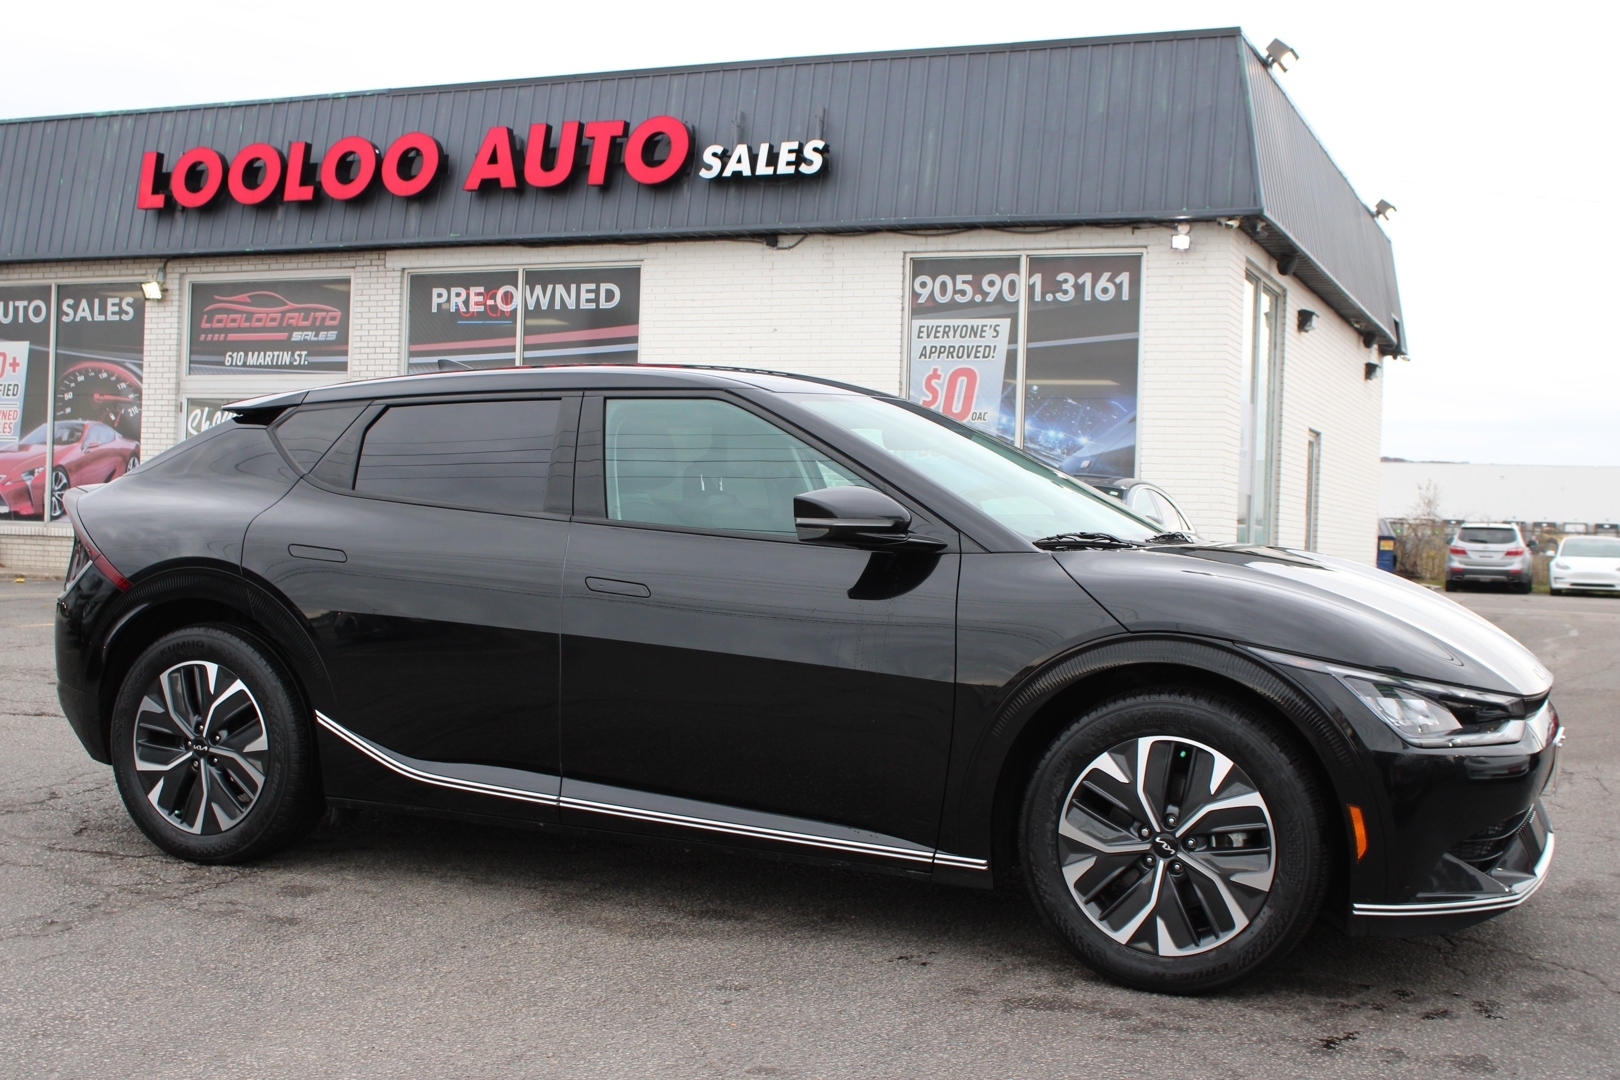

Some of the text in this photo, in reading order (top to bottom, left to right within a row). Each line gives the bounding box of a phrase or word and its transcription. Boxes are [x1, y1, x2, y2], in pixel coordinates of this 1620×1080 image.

[137, 115, 826, 210] LOOLOO AUTO SALES
[913, 272, 1131, 304] 905.901.3161
[431, 283, 621, 313] PRE-OWNED
[62, 296, 134, 322] SALES
[200, 311, 342, 328] LOOLOO AUTO
[290, 330, 339, 341] SALES
[916, 323, 1001, 339] EVERYONE'S
[224, 350, 309, 366] 610 MARTIN ST.
[918, 344, 998, 360] APPROVED!
[64, 391, 73, 401] 50
[921, 367, 989, 422] $0 OAC
